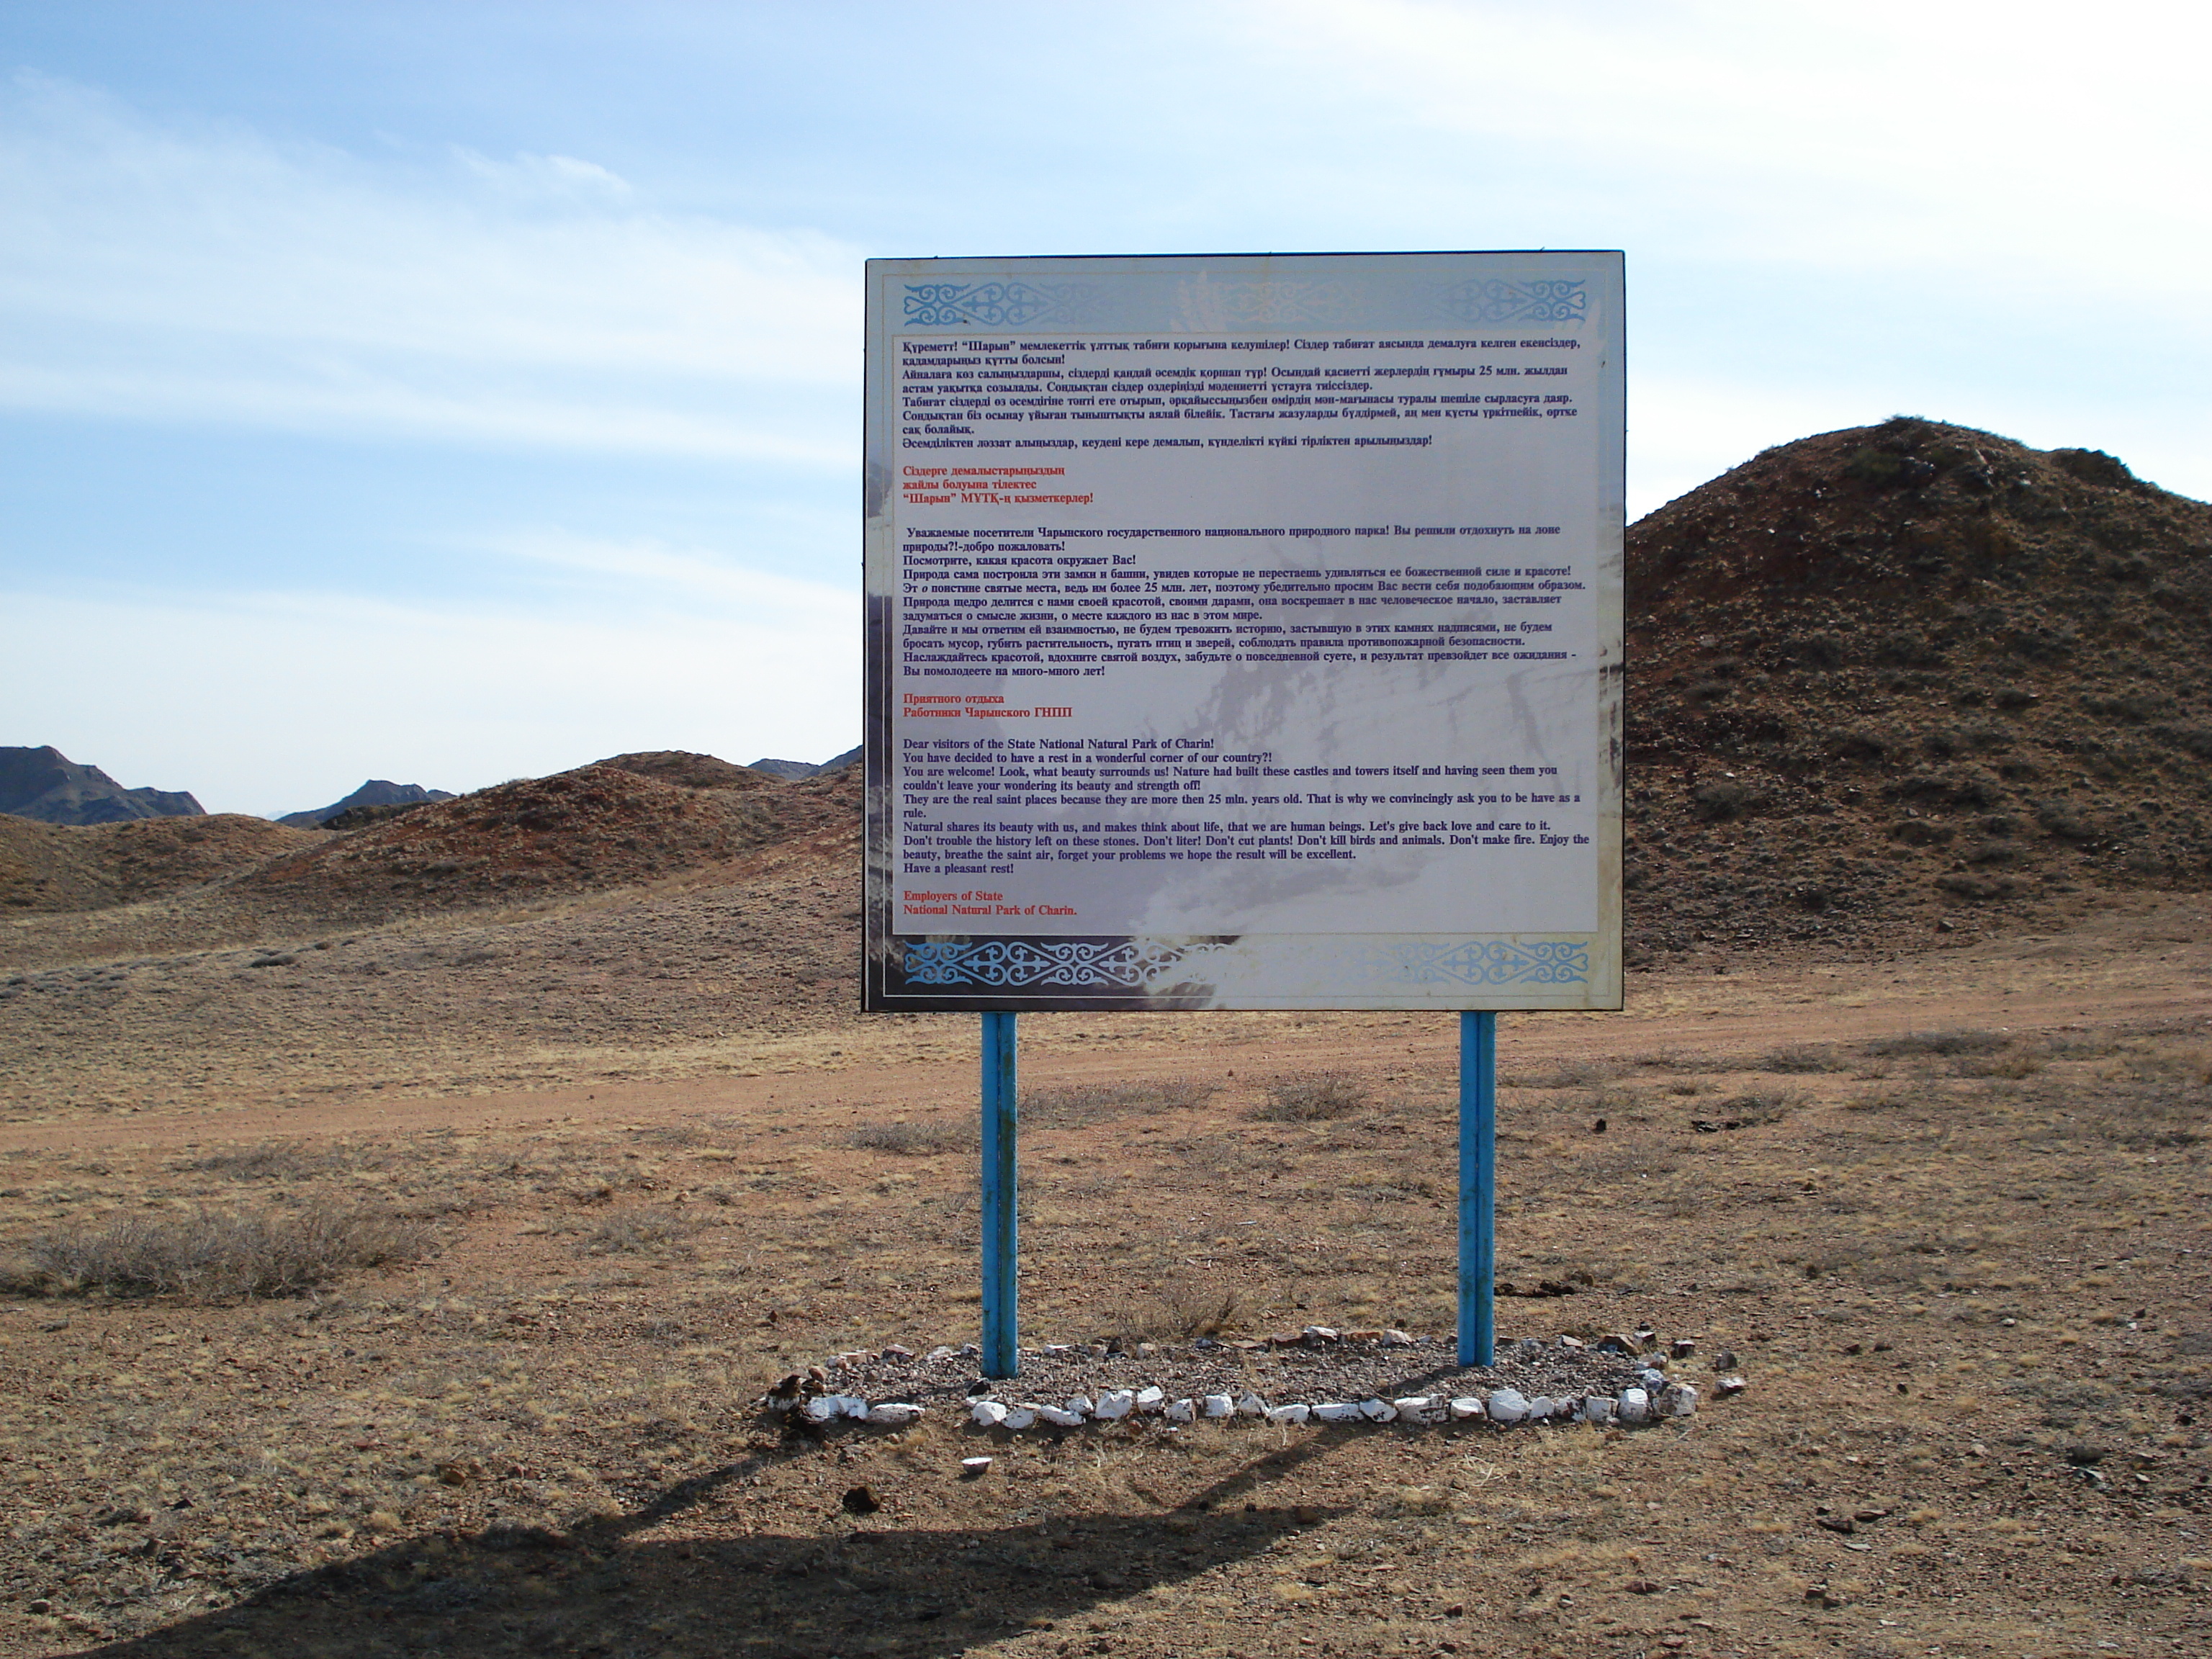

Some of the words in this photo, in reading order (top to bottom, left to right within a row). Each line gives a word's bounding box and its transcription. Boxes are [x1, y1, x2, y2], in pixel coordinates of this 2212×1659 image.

[906, 527, 970, 538] Уважаемые
[973, 529, 1035, 539] посетители
[1037, 526, 1104, 540] Чарынского
[1106, 529, 1202, 540] государственного
[1204, 528, 1286, 538] национального
[1288, 528, 1352, 539] природного
[1354, 524, 1390, 538] парка!
[1393, 524, 1411, 536] Вы
[1414, 527, 1456, 538] решили
[1459, 527, 1515, 538] отдохнуть
[1518, 526, 1532, 535] на
[1534, 526, 1561, 535] лоне
[902, 540, 995, 554] природы?!-добро
[997, 541, 1066, 552] пожаловать!
[902, 554, 972, 568] Посмотрите,
[976, 557, 1007, 565] какая
[1010, 557, 1053, 567] красота
[1056, 557, 1109, 567] окружает
[1112, 554, 1136, 565] Вас!
[903, 568, 950, 582] Природа
[953, 571, 980, 580] сама
[982, 571, 1039, 582] построила
[1041, 571, 1061, 580] эти
[1064, 570, 1097, 579] замки
[1100, 570, 1107, 579] и
[1110, 567, 1150, 580] башни,
[1153, 570, 1190, 581] увидев
[1193, 570, 1239, 581] которые
[1242, 570, 1256, 578] не
[1259, 570, 1322, 580] перестаешь
[1324, 569, 1386, 580] удивляться
[1389, 569, 1402, 577] ее
[1405, 565, 1483, 577] божественной
[1485, 568, 1511, 577] силе
[1514, 568, 1521, 577] и
[1524, 565, 1571, 579] красоте!
[903, 637, 945, 650] бросать
[948, 639, 984, 651] мусор,
[987, 637, 1022, 650] губить
[1025, 640, 1113, 651] растительность,
[1117, 639, 1153, 650] пугать
[1155, 639, 1182, 649] птиц
[1184, 639, 1192, 648] и
[1195, 637, 1235, 650] зверей,
[1238, 637, 1297, 649] соблюдать
[1300, 639, 1344, 649] правила
[1347, 637, 1445, 649] противопожарной
[1448, 636, 1526, 647] безопасности.
[903, 665, 921, 677] Вы
[923, 667, 992, 677] помолодеете
[995, 667, 1008, 676] на
[1012, 667, 1080, 677] много-много
[1082, 665, 1105, 677] лет!
[903, 693, 962, 706] Приятного
[965, 696, 1004, 705] отдыха
[903, 706, 961, 718] Работники
[965, 707, 1031, 720] Чарынского
[1034, 706, 1073, 718] ГНПП
[903, 738, 930, 750] Dear
[932, 738, 970, 749] visitors
[973, 738, 985, 749] of
[987, 738, 1004, 749] the
[1007, 738, 1036, 750] State
[1038, 738, 1084, 750] National
[1087, 738, 1128, 750] Natural
[1131, 738, 1158, 750] Park
[1160, 738, 1173, 750] of
[1174, 737, 1214, 749] Charin!
[902, 752, 924, 763] You
[927, 752, 951, 763] have
[954, 752, 993, 763] decided
[996, 753, 1007, 763] to
[1010, 752, 1035, 763] have
[1038, 755, 1045, 764] a
[1048, 754, 1069, 764] rest
[1071, 752, 1082, 763] in
[1085, 755, 1092, 763] a
[1095, 752, 1146, 763] wonderful
[1149, 755, 1184, 763] corner
[1187, 752, 1200, 763] of
[1201, 755, 1220, 763] our
[1222, 752, 1272, 765] country?!
[903, 766, 924, 777] You
[947, 765, 995, 777] welcome!
[999, 765, 1030, 778] Look,
[1033, 766, 1058, 777] what
[1061, 766, 1096, 779] beauty
[1099, 766, 1151, 777] surrounds
[1154, 766, 1169, 777] us!
[1172, 765, 1210, 777] Nature
[1213, 765, 1233, 776] had
[1236, 765, 1259, 776] built
[1262, 765, 1290, 777] these
[1293, 765, 1329, 776] castles
[1331, 765, 1352, 776] and
[1354, 766, 1390, 776] towers
[1393, 765, 1420, 776] itself
[1421, 765, 1442, 775] and
[1444, 764, 1479, 778] having
[1481, 767, 1506, 775] seen
[1509, 764, 1535, 775] them
[1538, 767, 1558, 778] you
[903, 780, 944, 791] couldn't
[947, 780, 974, 791] leave
[976, 783, 1001, 793] your
[1004, 780, 1057, 793] wondering
[1060, 780, 1074, 791] its
[1076, 780, 1112, 793] beauty
[1114, 780, 1133, 791] and
[1136, 780, 1180, 793] strength
[903, 807, 927, 819] rule.
[903, 849, 941, 862] beauty,
[944, 849, 984, 860] breathe
[986, 849, 1004, 860] the
[1007, 849, 1032, 860] saint
[1035, 850, 1054, 862] air,
[1057, 849, 1089, 863] forget
[1092, 852, 1116, 863] your
[1119, 849, 1166, 862] problems
[1169, 851, 1184, 860] we
[1187, 849, 1213, 862] hope
[1215, 849, 1233, 860] the
[1236, 849, 1266, 860] result
[1268, 848, 1287, 860] will
[1290, 848, 1303, 860] be
[1306, 848, 1357, 860] excellent.
[903, 863, 931, 873] Have
[944, 863, 987, 876] pleasant
[990, 863, 1014, 873] rest!
[903, 890, 958, 904] Employers
[961, 891, 973, 902] of
[975, 891, 1003, 902] State
[903, 904, 948, 915] National
[952, 904, 992, 915] Natural
[995, 904, 1021, 916] Park
[1024, 904, 1036, 916] of
[1038, 904, 1077, 916] Charin.
